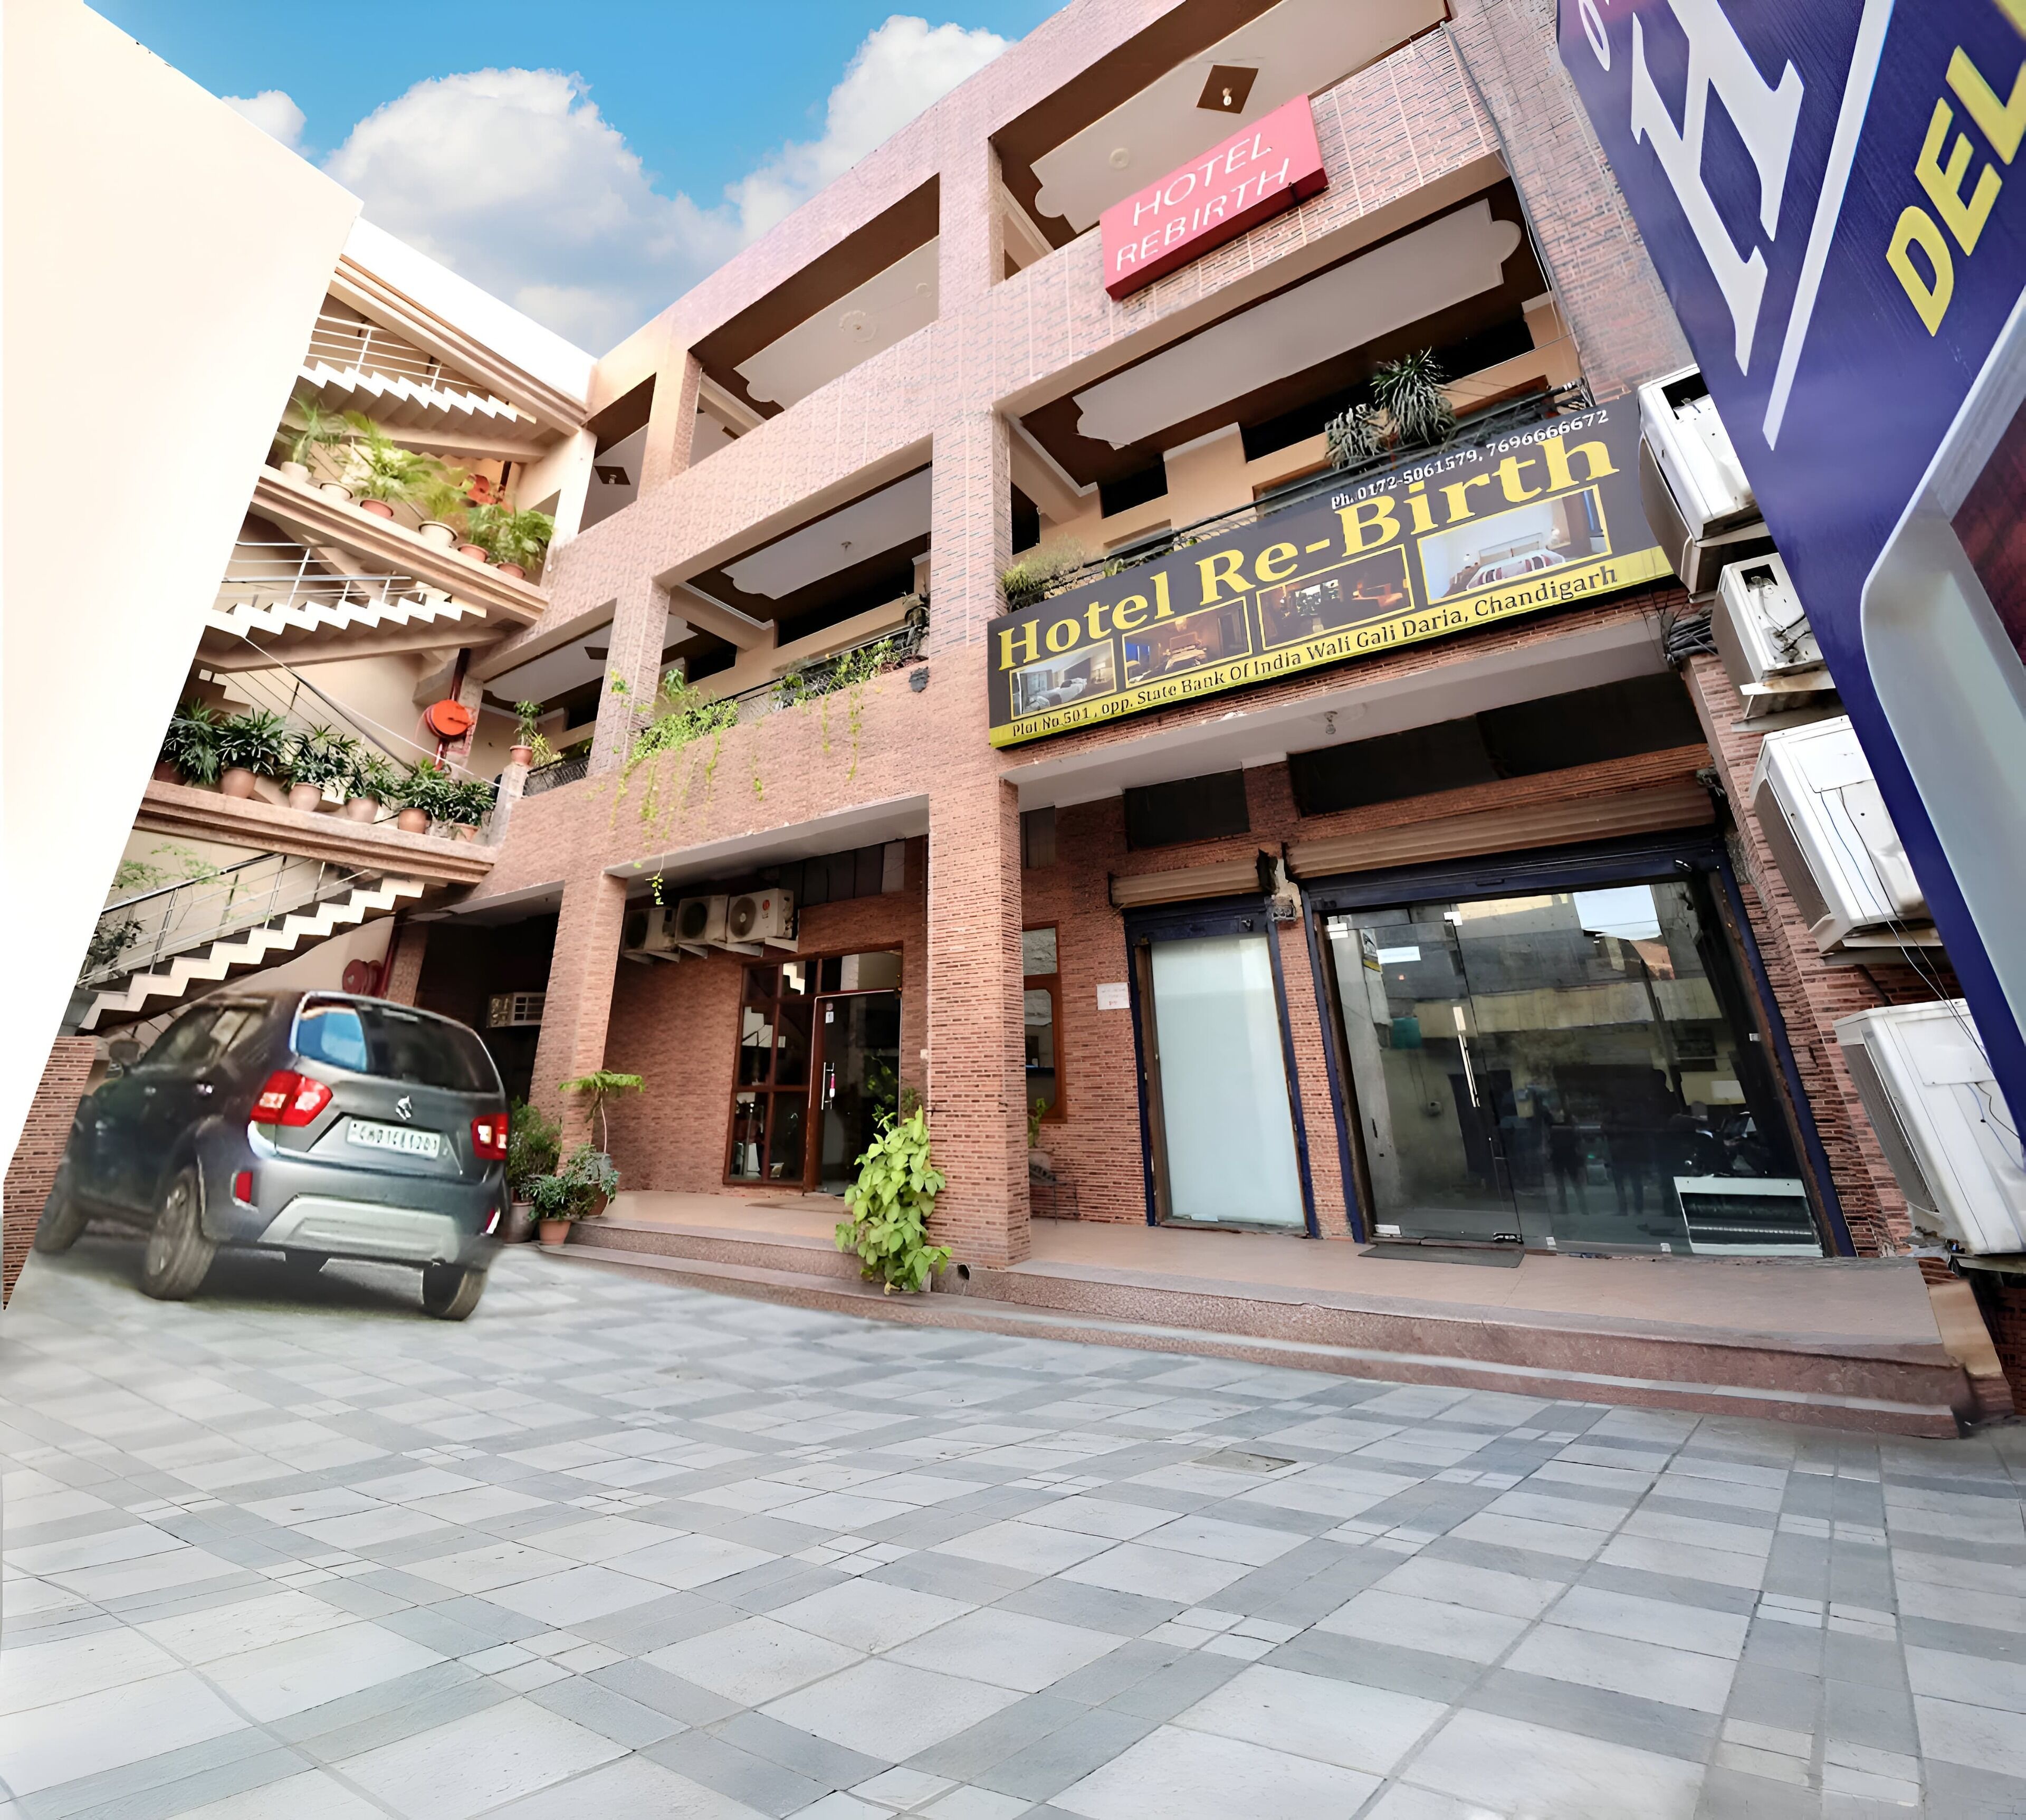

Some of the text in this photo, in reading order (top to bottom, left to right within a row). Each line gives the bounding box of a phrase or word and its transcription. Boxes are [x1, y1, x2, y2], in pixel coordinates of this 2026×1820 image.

[1116, 158, 1289, 271] REBIRTH
[1133, 132, 1273, 226] HOTEL
[1886, 0, 2026, 337] DEL
[998, 434, 1620, 672] Hotel Re-Birth
[1102, 698, 1133, 715] opp.
[1137, 685, 1177, 705] State
[1181, 671, 1226, 693] Bank
[1230, 663, 1249, 681] Of
[1254, 650, 1302, 676] India
[1308, 637, 1351, 661] Wali
[1356, 624, 1396, 649] Gali
[1402, 608, 1469, 637] Daria,
[1475, 565, 1618, 617] Chandigarh
